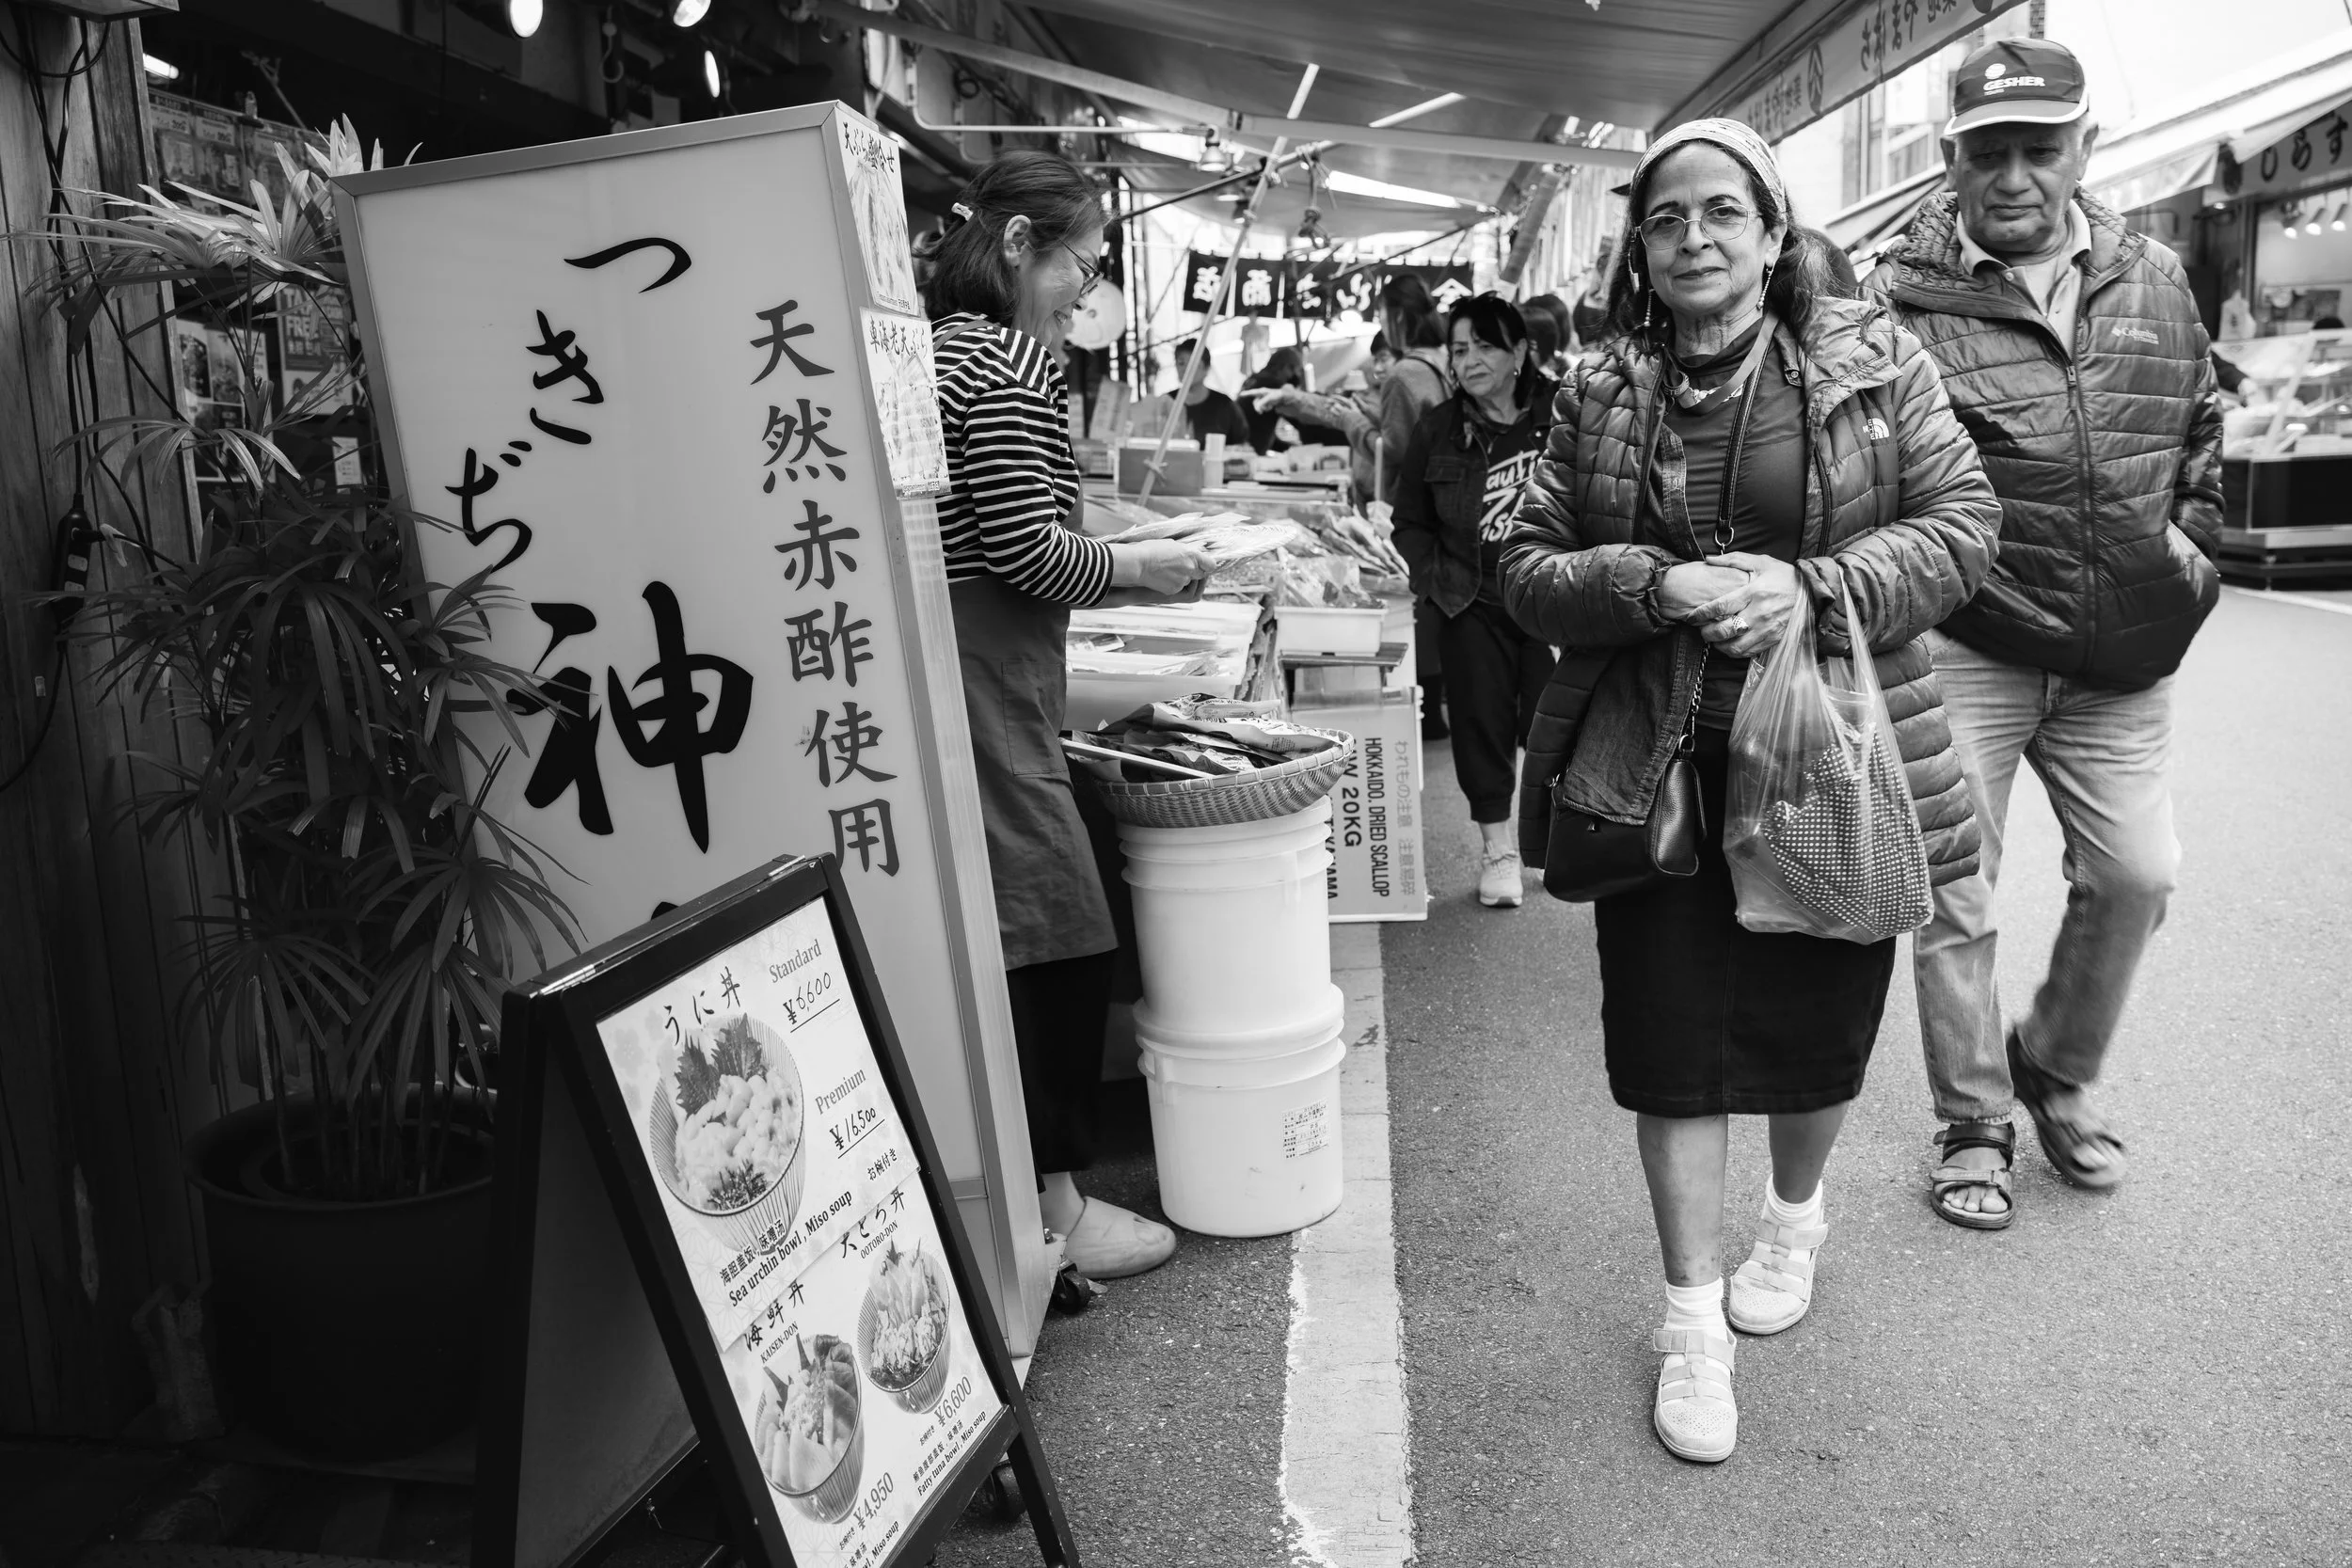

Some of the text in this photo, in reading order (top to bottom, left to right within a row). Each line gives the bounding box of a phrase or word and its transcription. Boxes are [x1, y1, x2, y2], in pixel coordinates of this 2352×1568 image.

[1983, 76, 2045, 90] GESHER
[286, 315, 320, 338] FRE
[750, 299, 900, 877] 天然赤酢使用
[1342, 786, 1362, 847] 20KG
[1365, 737, 1390, 897] HOKKAIDO. DRIED SCALLOP
[769, 939, 822, 984] Standard
[664, 966, 741, 1046] うに丼
[815, 1069, 866, 1115] Premium
[866, 1148, 898, 1181] お椀付き
[729, 1277, 749, 1307] Sea
[748, 1255, 780, 1295] urchin
[805, 1213, 829, 1237] Miso
[829, 1191, 853, 1216] soup
[860, 1220, 898, 1259] OOTORO-DON
[760, 1322, 799, 1364] KAISEN-DON
[934, 1376, 972, 1428] ¥6,600
[917, 1472, 934, 1497] Fatty
[931, 1461, 946, 1481] tuna
[961, 1428, 974, 1446] Miso
[973, 1411, 987, 1430] soup
[853, 1472, 894, 1530] ¥4,950
[871, 1541, 886, 1560] Miso
[885, 1520, 899, 1541] soup
